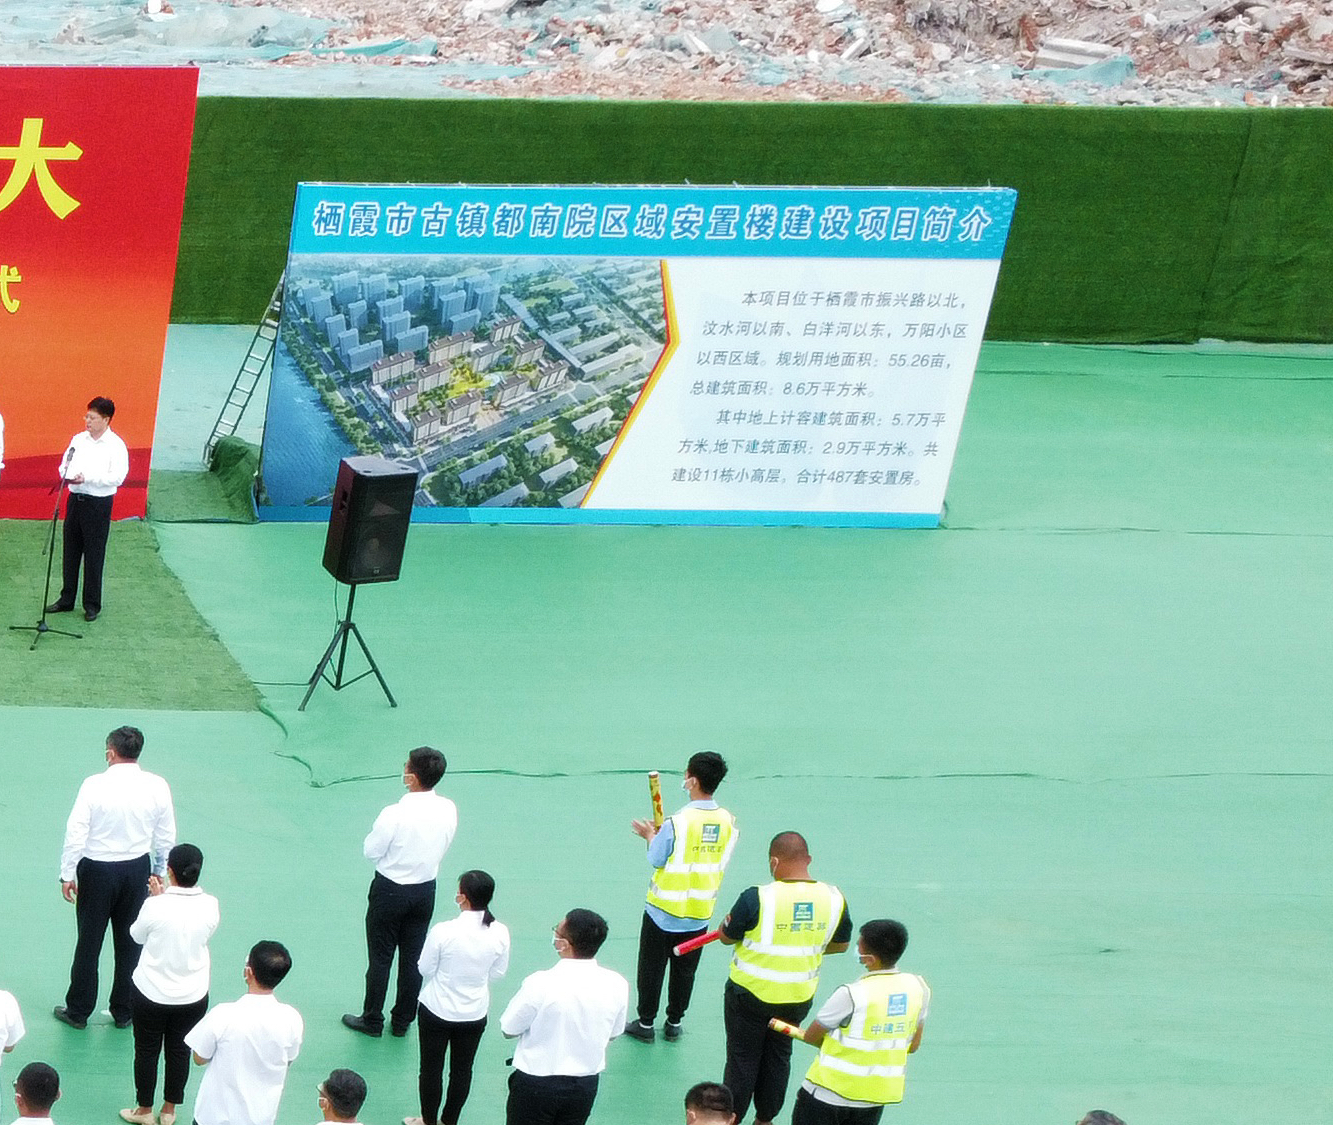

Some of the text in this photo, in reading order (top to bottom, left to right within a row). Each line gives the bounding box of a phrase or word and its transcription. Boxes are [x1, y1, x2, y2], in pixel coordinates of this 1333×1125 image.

[313, 201, 992, 243] 栖霞市古镇都南院区域安置楼建设项目简介
